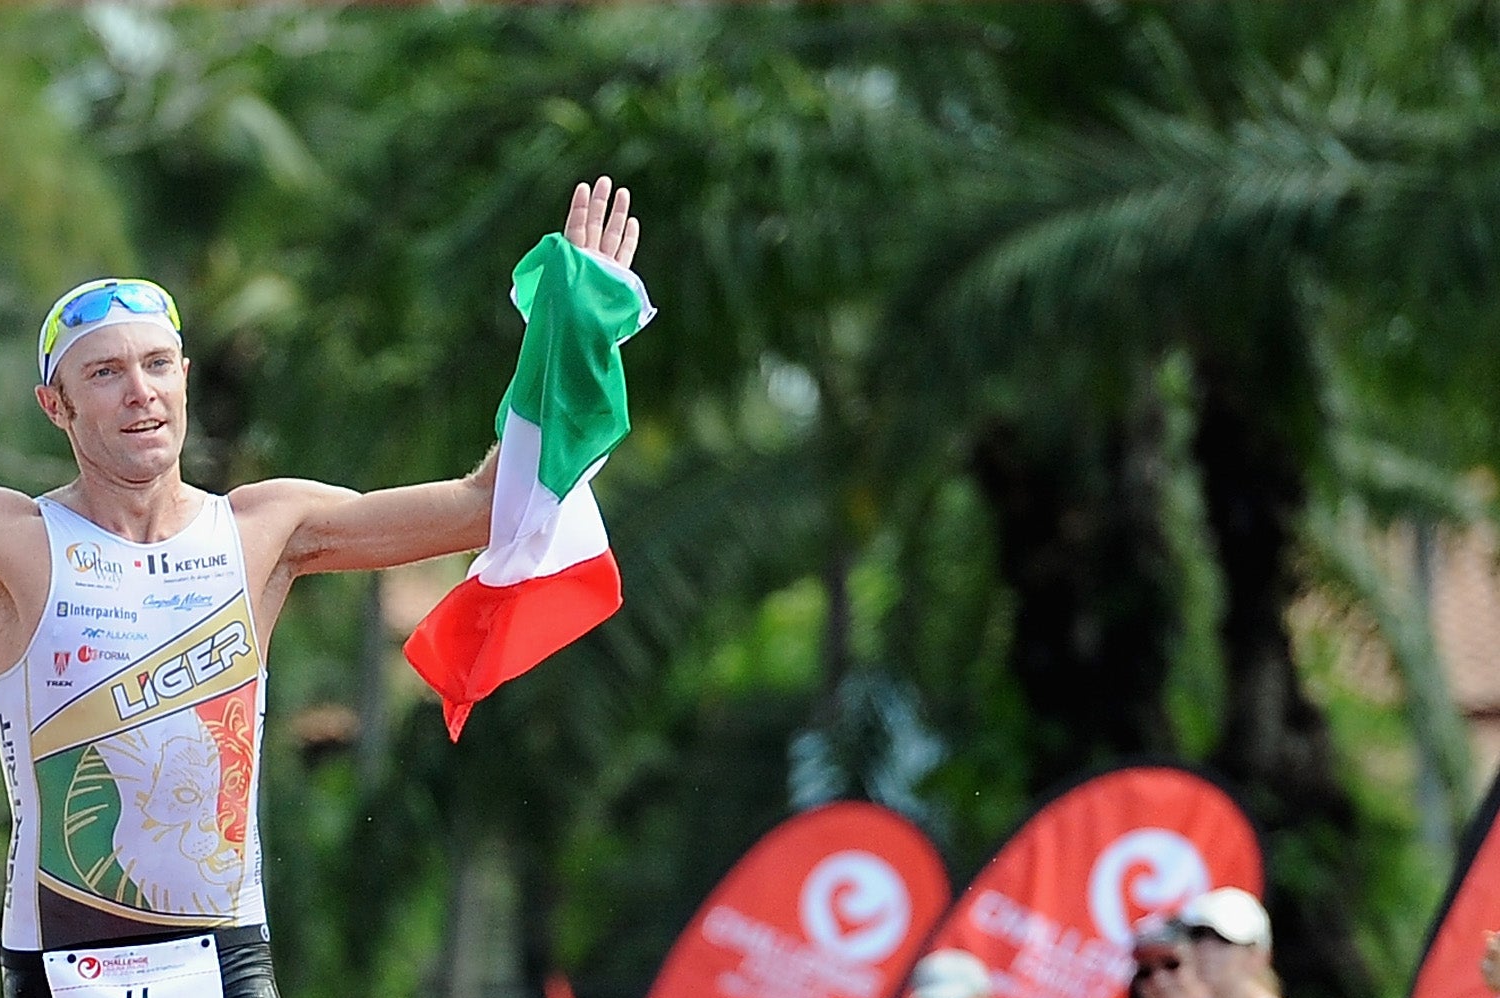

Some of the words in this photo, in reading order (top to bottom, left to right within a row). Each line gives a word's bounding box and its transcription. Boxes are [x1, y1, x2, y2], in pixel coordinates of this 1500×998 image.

[175, 554, 228, 573] KEYLINE
[70, 603, 137, 623] Interparking
[111, 620, 252, 721] LIGER
[46, 680, 74, 688] TREK
